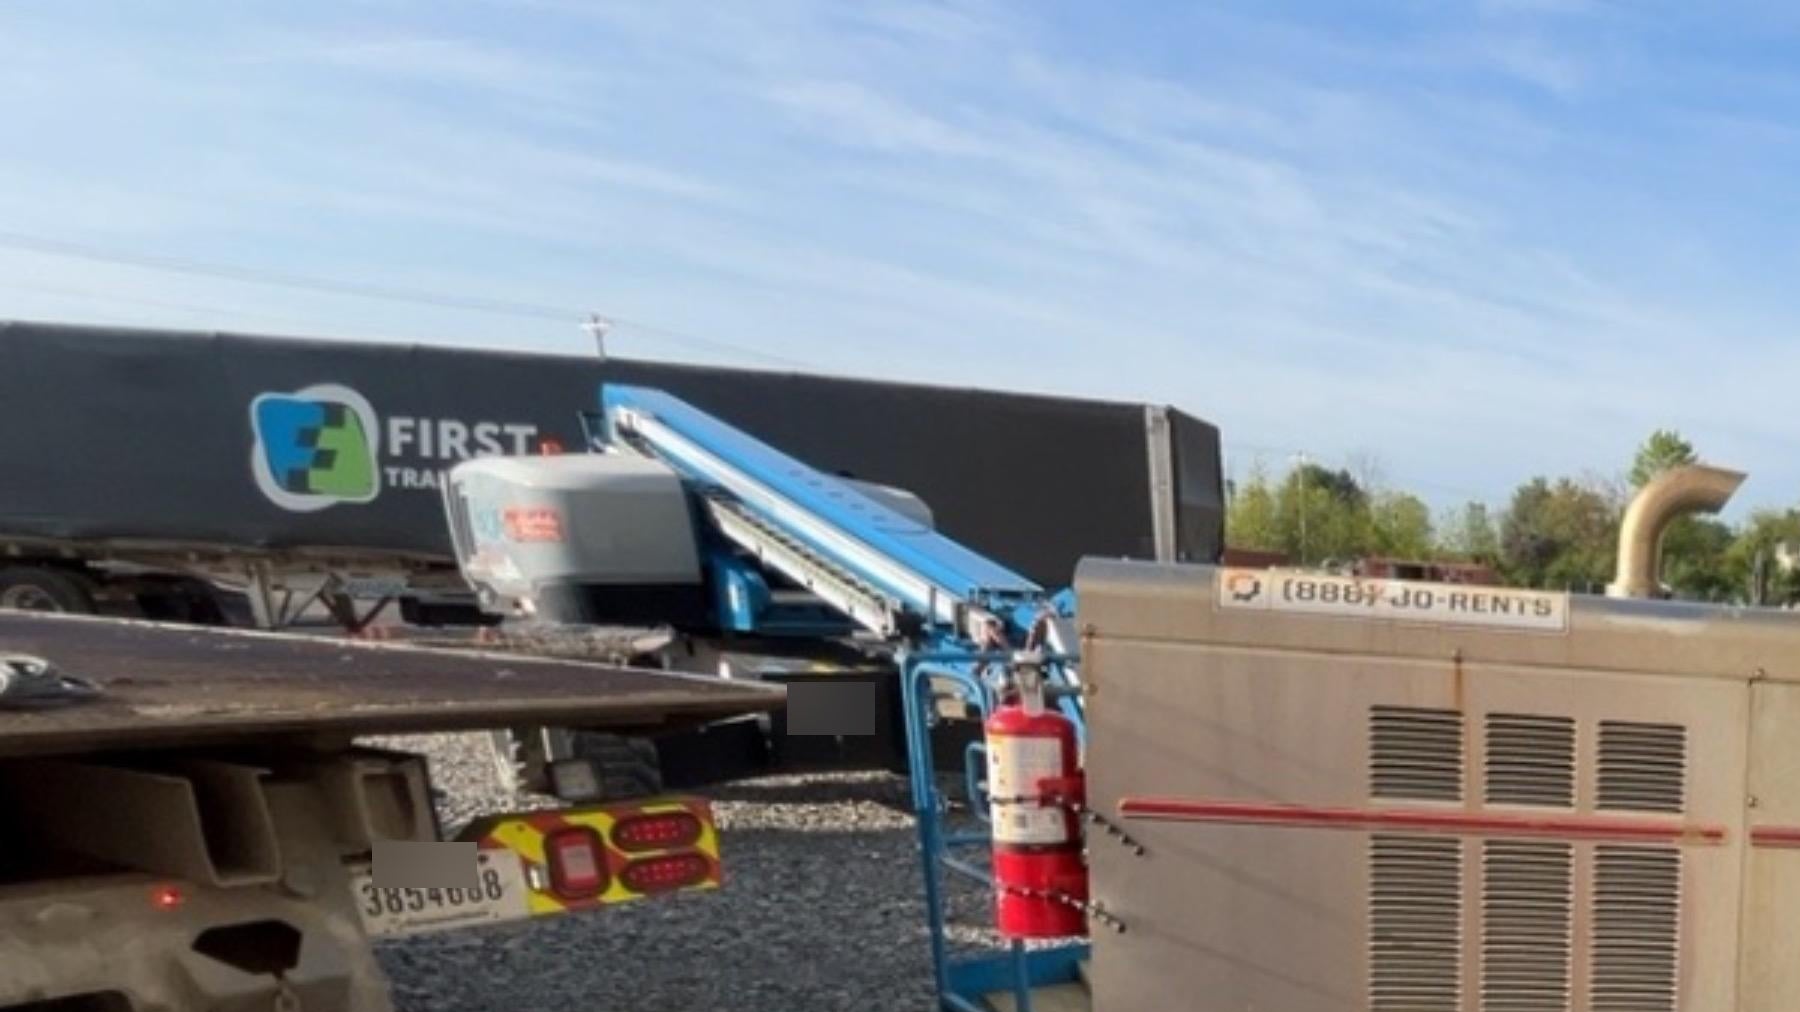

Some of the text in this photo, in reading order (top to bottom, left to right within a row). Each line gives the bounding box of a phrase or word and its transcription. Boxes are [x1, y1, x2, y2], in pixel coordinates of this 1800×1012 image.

[387, 416, 538, 460] FIRST
[385, 466, 443, 489] TRA
[1391, 588, 1553, 617] JO-RENTS
